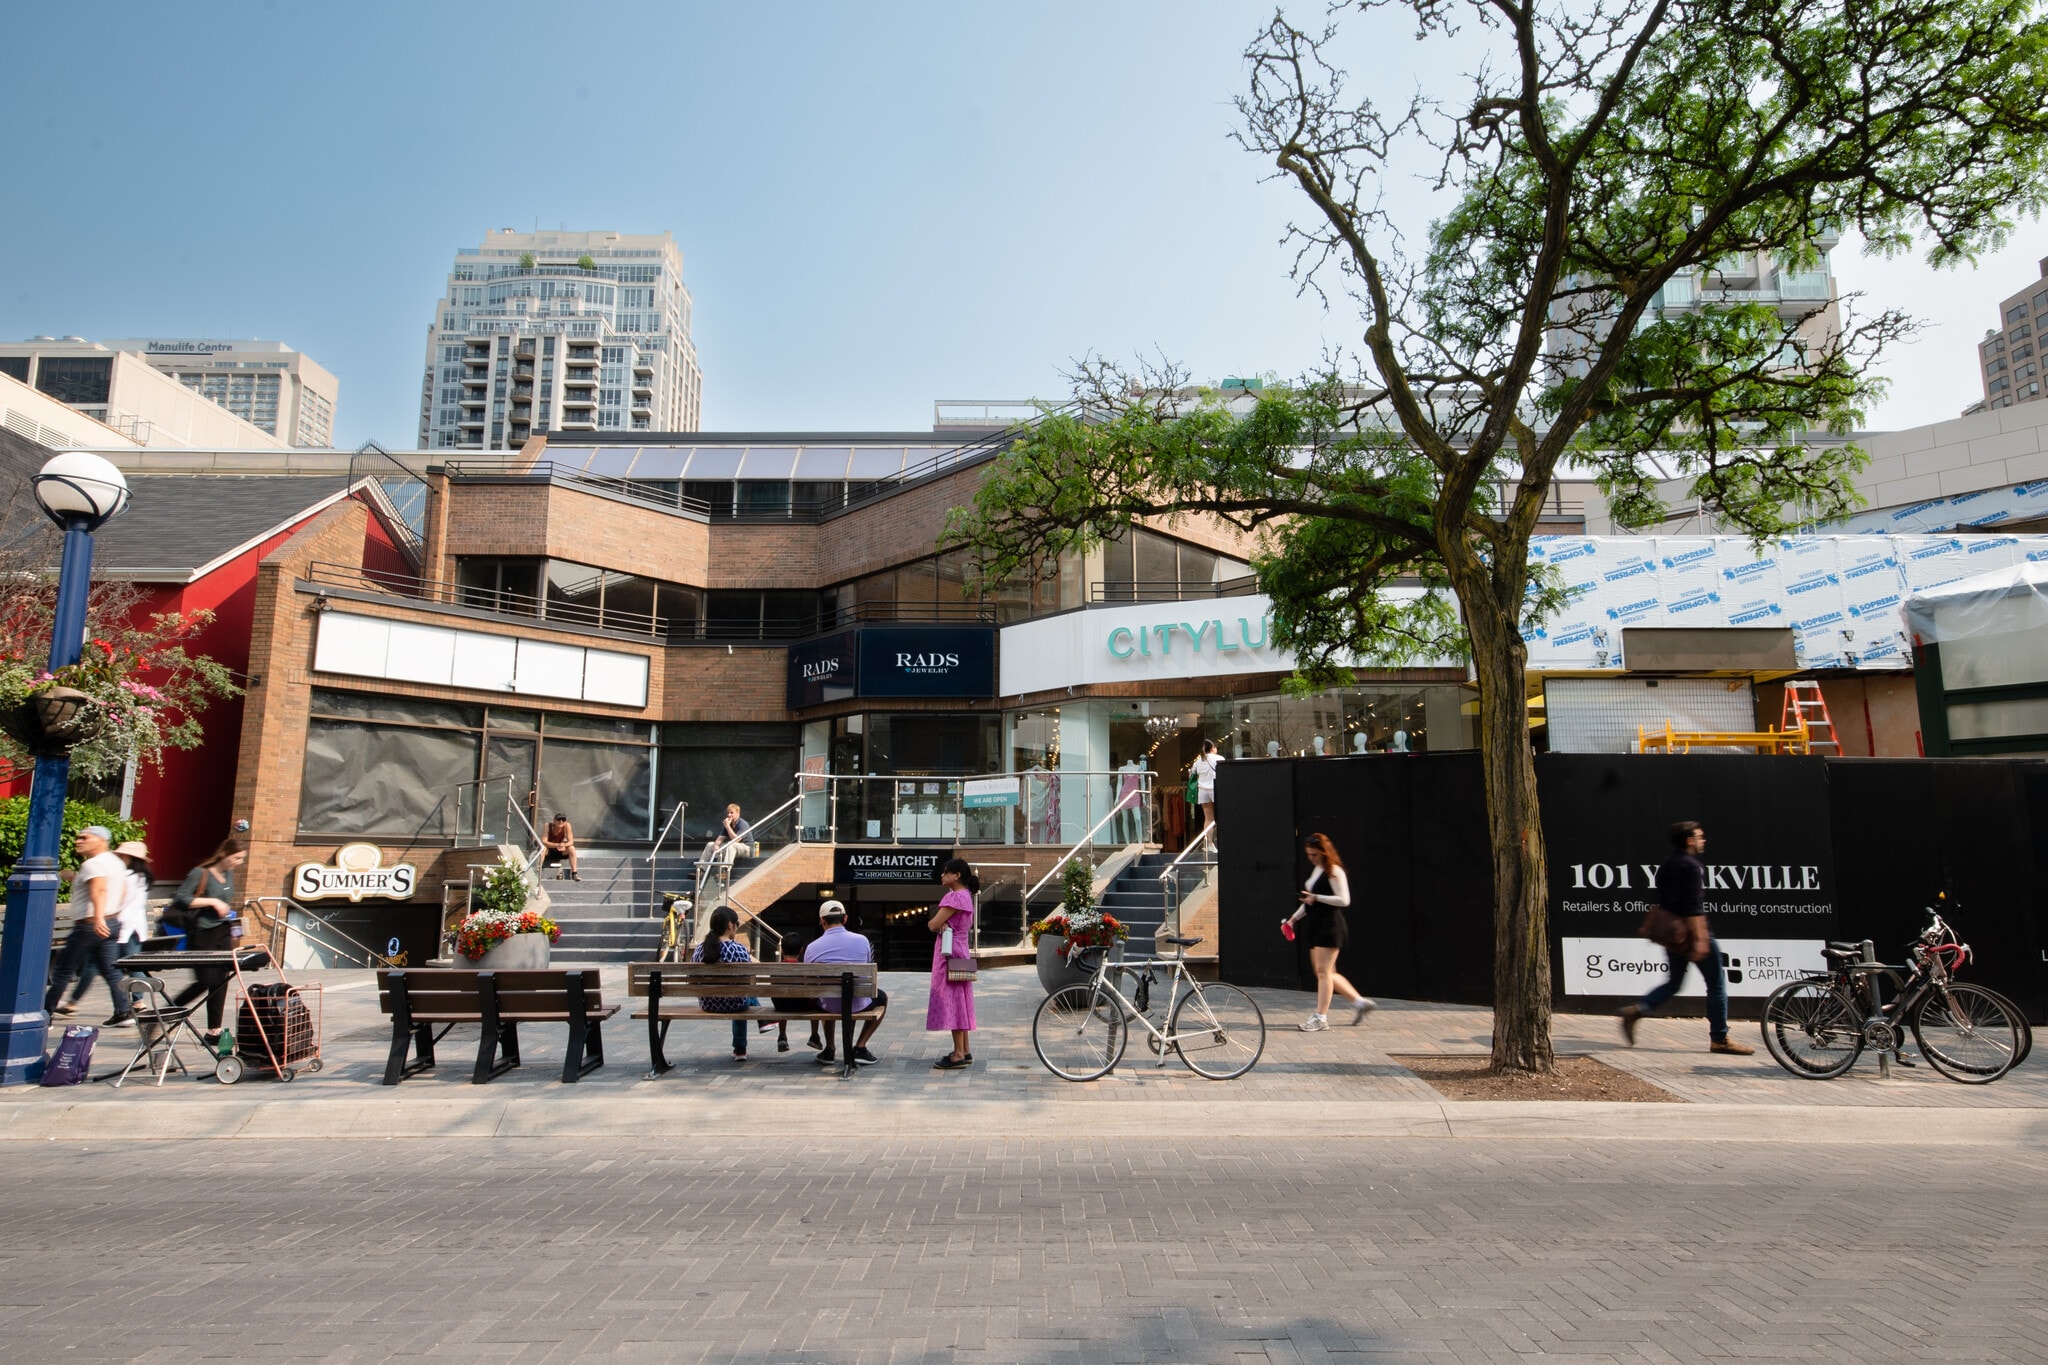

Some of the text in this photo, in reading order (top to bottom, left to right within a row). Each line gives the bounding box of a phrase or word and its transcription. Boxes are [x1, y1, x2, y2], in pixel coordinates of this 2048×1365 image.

[148, 342, 233, 352] Manulife Centre
[1550, 549, 1585, 563] SOPREM
[1673, 546, 1714, 563] SOPREMA
[1911, 545, 1953, 560] SOPREMA
[1604, 566, 1646, 582] SOPREMA
[1733, 558, 1775, 574] SOPREMA
[1845, 563, 1886, 580] SOPREMA
[1787, 580, 1828, 596] SOPREMA
[1617, 598, 1659, 614] SOPREMA
[1668, 597, 1709, 614] SOPREMA
[1859, 594, 1900, 611] SOPREMA
[1729, 609, 1770, 625] SOPREMA
[1800, 611, 1842, 627] SOPREMA
[1107, 616, 1268, 659] CITYLU
[1552, 633, 1591, 647] SOPREM
[802, 657, 839, 678] RADS
[895, 652, 959, 667] RADS
[811, 673, 833, 682] JEWELRY
[300, 868, 411, 894] SUMMER'S
[1570, 863, 1821, 891] 101 YKVILLE
[1562, 900, 1611, 913] Retailers
[1612, 901, 1622, 913] &
[1720, 902, 1758, 916] during
[1759, 903, 1832, 914] construction!
[1747, 956, 1782, 967] FIRST
[1748, 969, 1801, 980] CAPITAL
